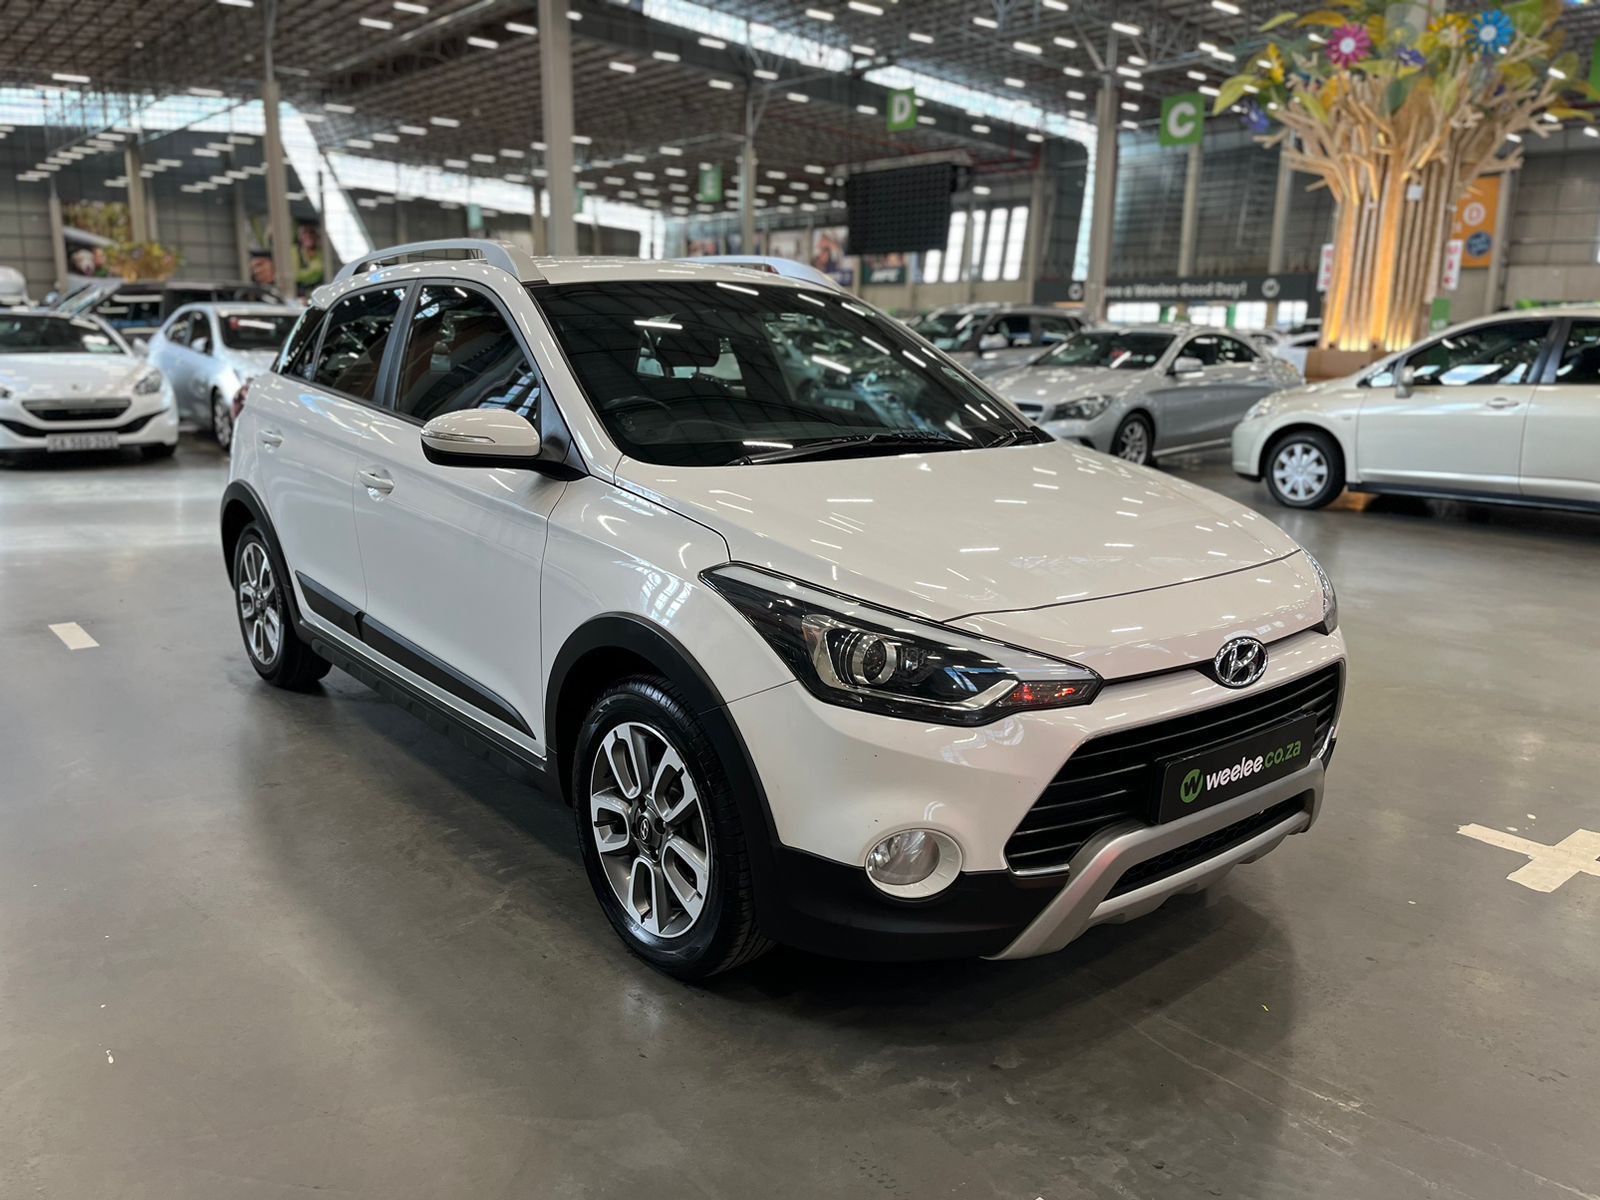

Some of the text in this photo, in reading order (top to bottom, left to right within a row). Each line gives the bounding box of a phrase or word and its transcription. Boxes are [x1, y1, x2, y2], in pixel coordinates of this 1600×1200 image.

[892, 94, 912, 123] D
[1168, 102, 1196, 138] C
[1180, 282, 1213, 297] Good
[1206, 741, 1301, 791] weelee.co.za
